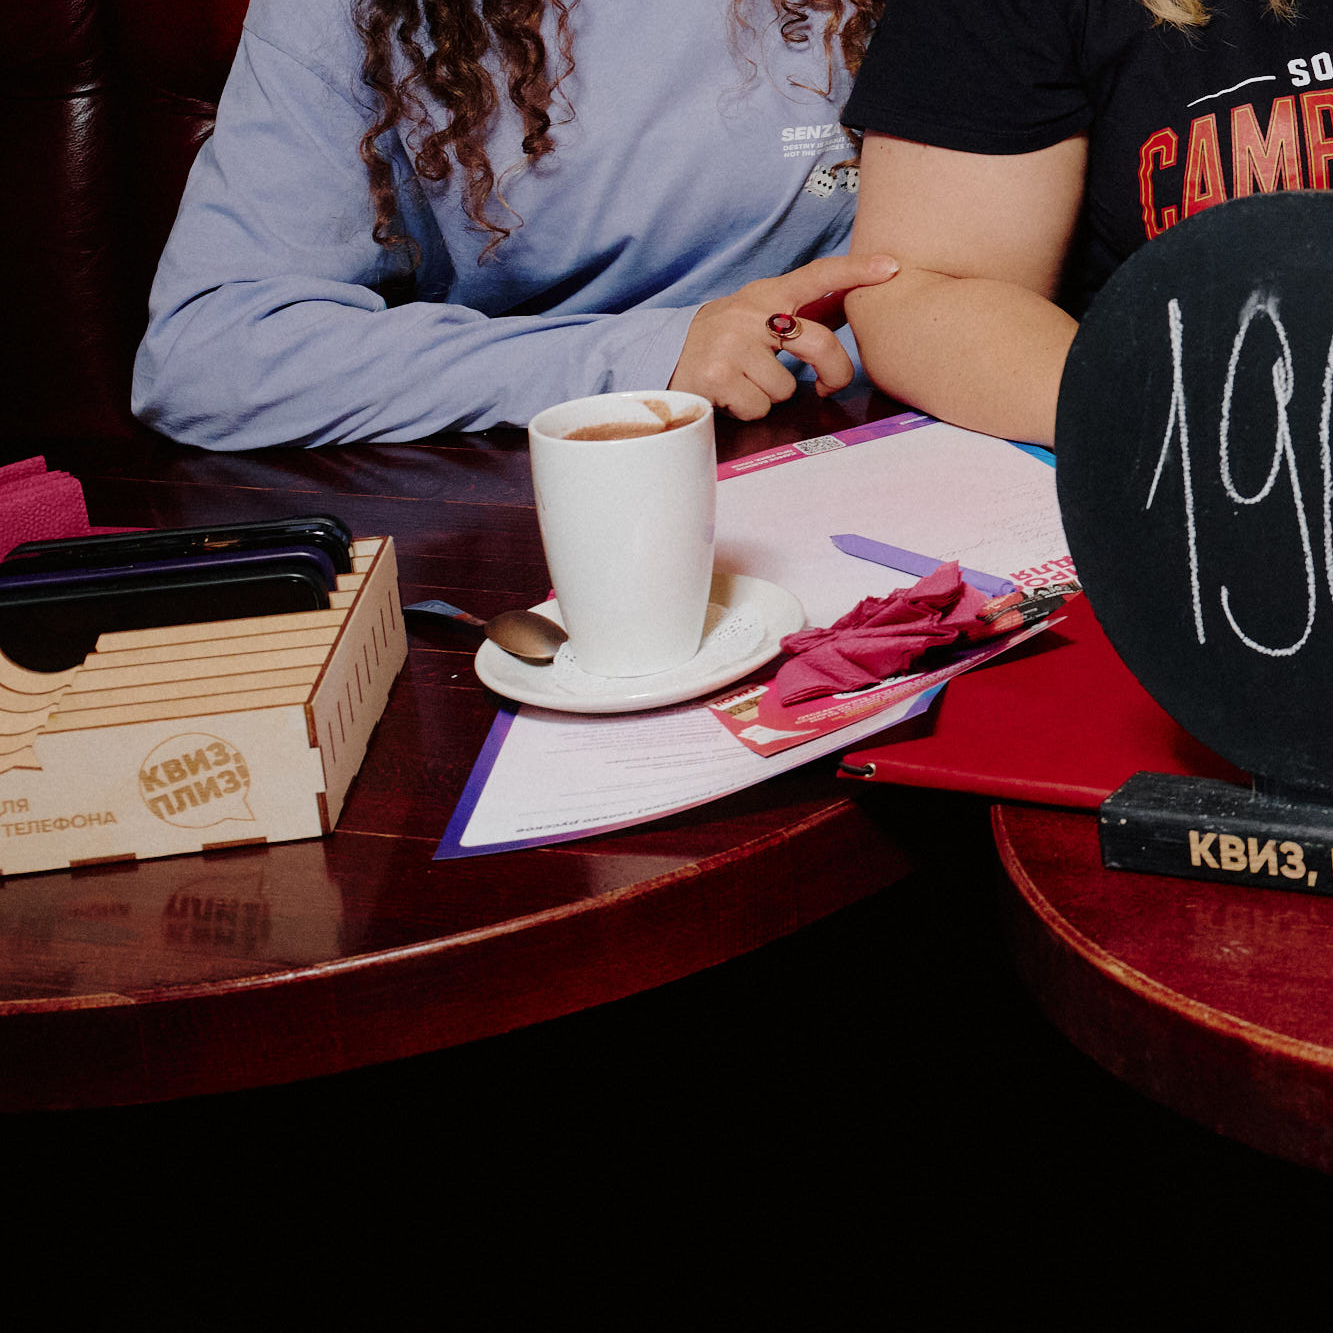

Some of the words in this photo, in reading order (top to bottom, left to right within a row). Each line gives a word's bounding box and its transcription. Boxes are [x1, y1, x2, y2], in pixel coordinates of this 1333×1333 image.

[139, 741, 246, 792] КВИЗ,
[147, 764, 250, 820] ПЛИЗ!
[0, 798, 30, 816] ЛЯ
[3, 811, 118, 838] ТЕЛЕФОНА
[1188, 829, 1318, 887] КВИЗ,
